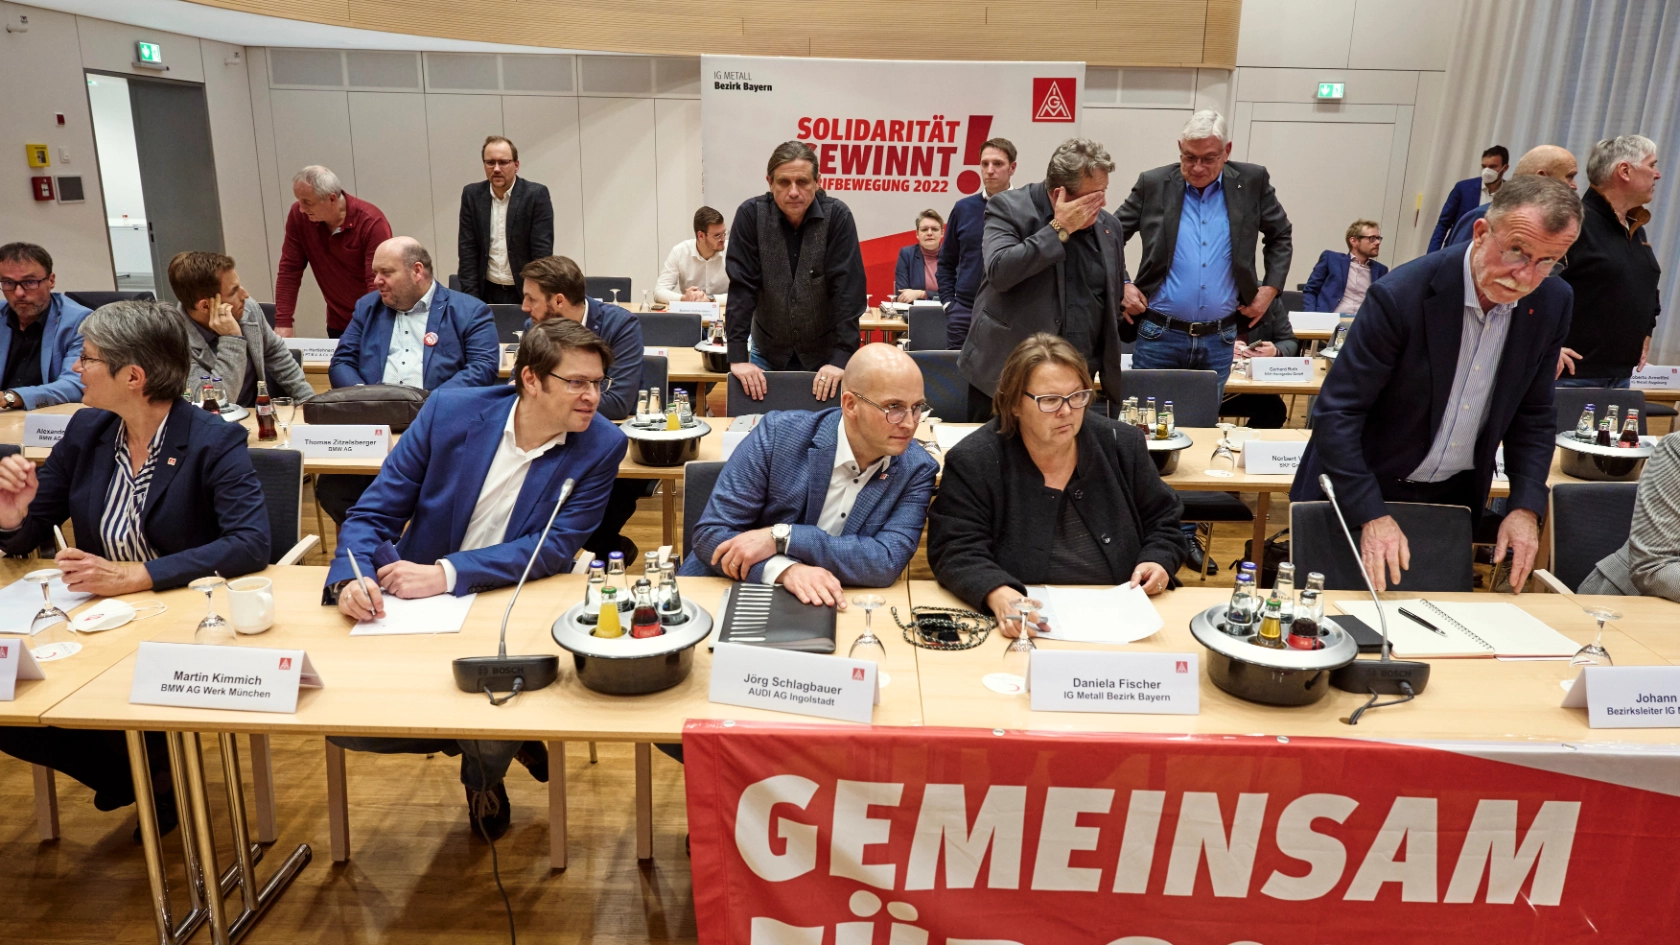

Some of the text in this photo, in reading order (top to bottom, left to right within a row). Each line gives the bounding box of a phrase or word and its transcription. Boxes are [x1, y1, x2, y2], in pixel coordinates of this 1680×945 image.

[713, 71, 752, 81] IG METALL
[714, 81, 773, 92] Bezirk Bayern
[797, 114, 961, 143] SOLIDARITÄT
[806, 143, 958, 177] EWINNT
[913, 179, 949, 193] 2022
[333, 438, 377, 447] Zitzelsberger
[173, 670, 262, 685] Martin Kimmich
[492, 667, 524, 675] BOSCH
[743, 673, 843, 695] Jörg Schlagbauer
[1073, 677, 1162, 690] Daniela Fischer
[160, 683, 271, 698] BMW AG Werk München
[748, 687, 835, 706] AUDI AG Ingolstadt
[1063, 691, 1171, 703] IG Metall Bezirk Bayern
[1635, 693, 1678, 703] Johann
[1607, 706, 1663, 716] Bezirksleiter
[1665, 706, 1676, 715] IG
[735, 773, 1582, 906] GEMEINSAM
